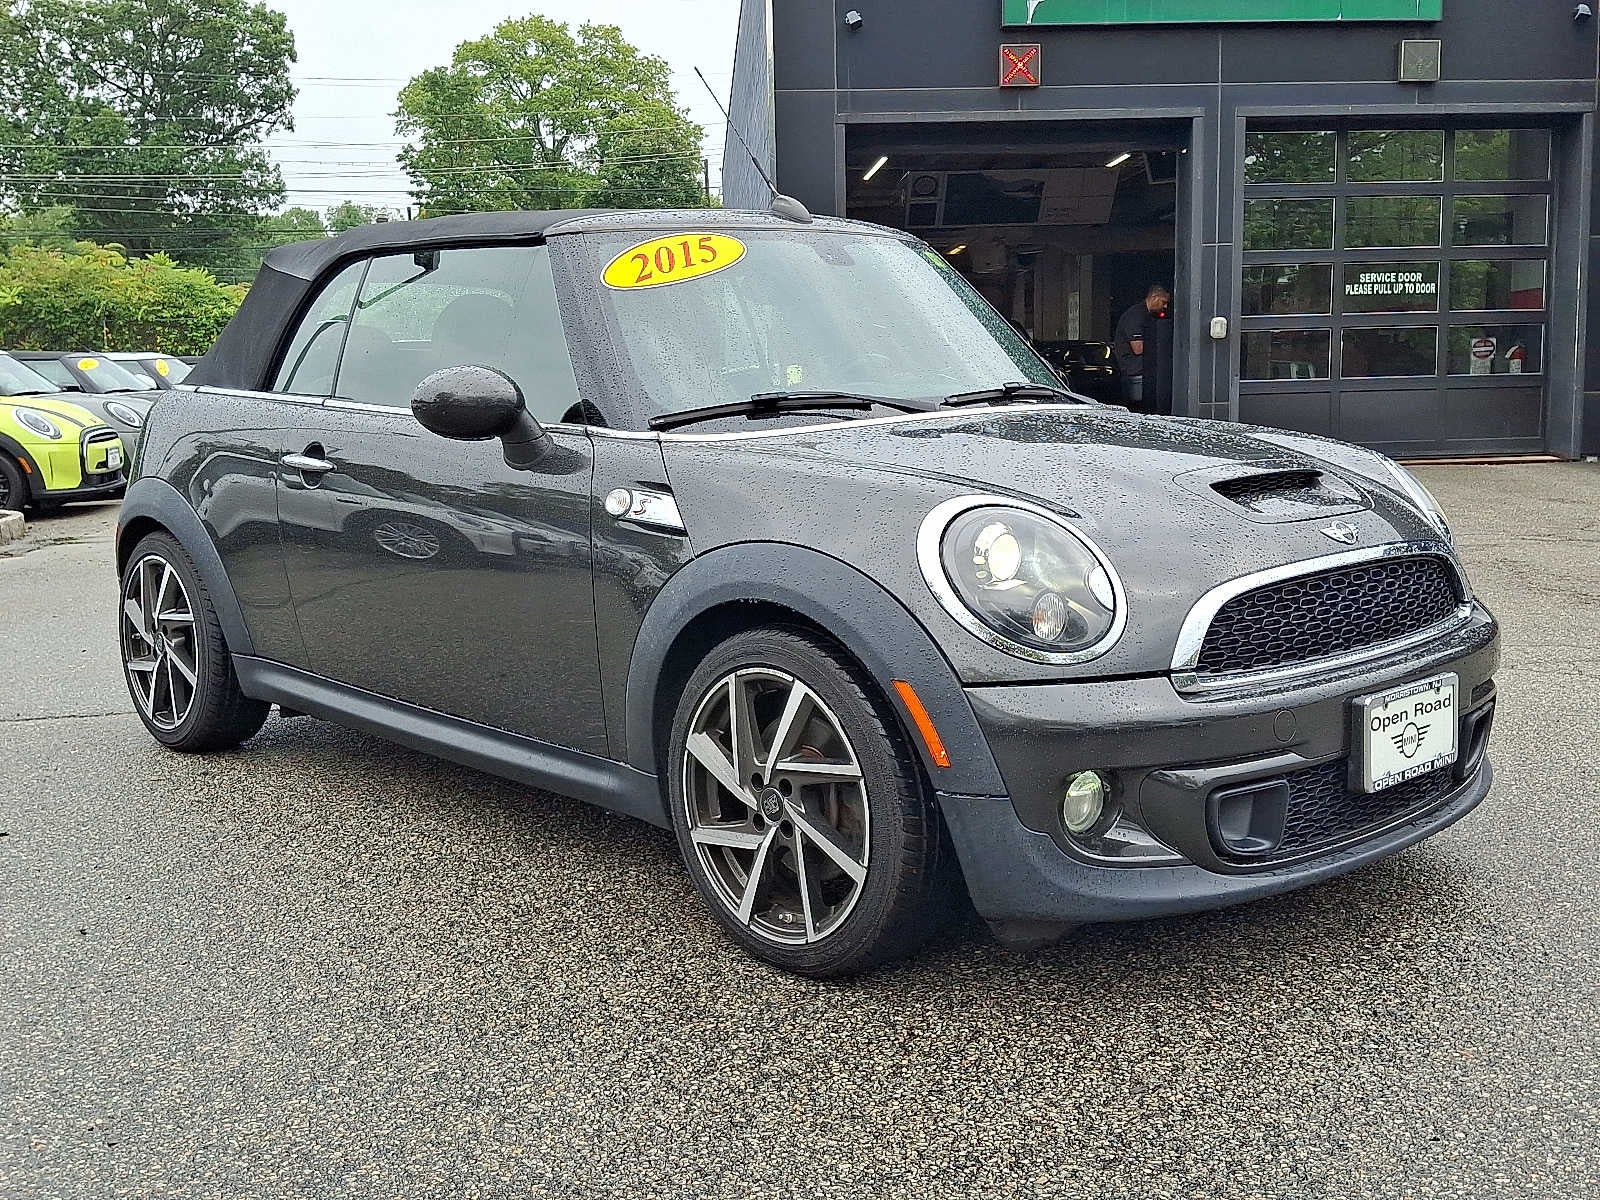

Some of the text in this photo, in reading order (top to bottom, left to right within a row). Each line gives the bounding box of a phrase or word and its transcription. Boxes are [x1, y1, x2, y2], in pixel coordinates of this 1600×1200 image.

[631, 237, 717, 284] 2015
[1360, 272, 1423, 283] SERVICE DOOR
[1345, 282, 1436, 295] PLEASE PULL UP TO DOOR
[1432, 679, 1443, 690] NJ
[1370, 693, 1452, 733] Open Road
[1403, 733, 1418, 747] MINI
[1374, 752, 1456, 791] OPEN ROAD MINI
